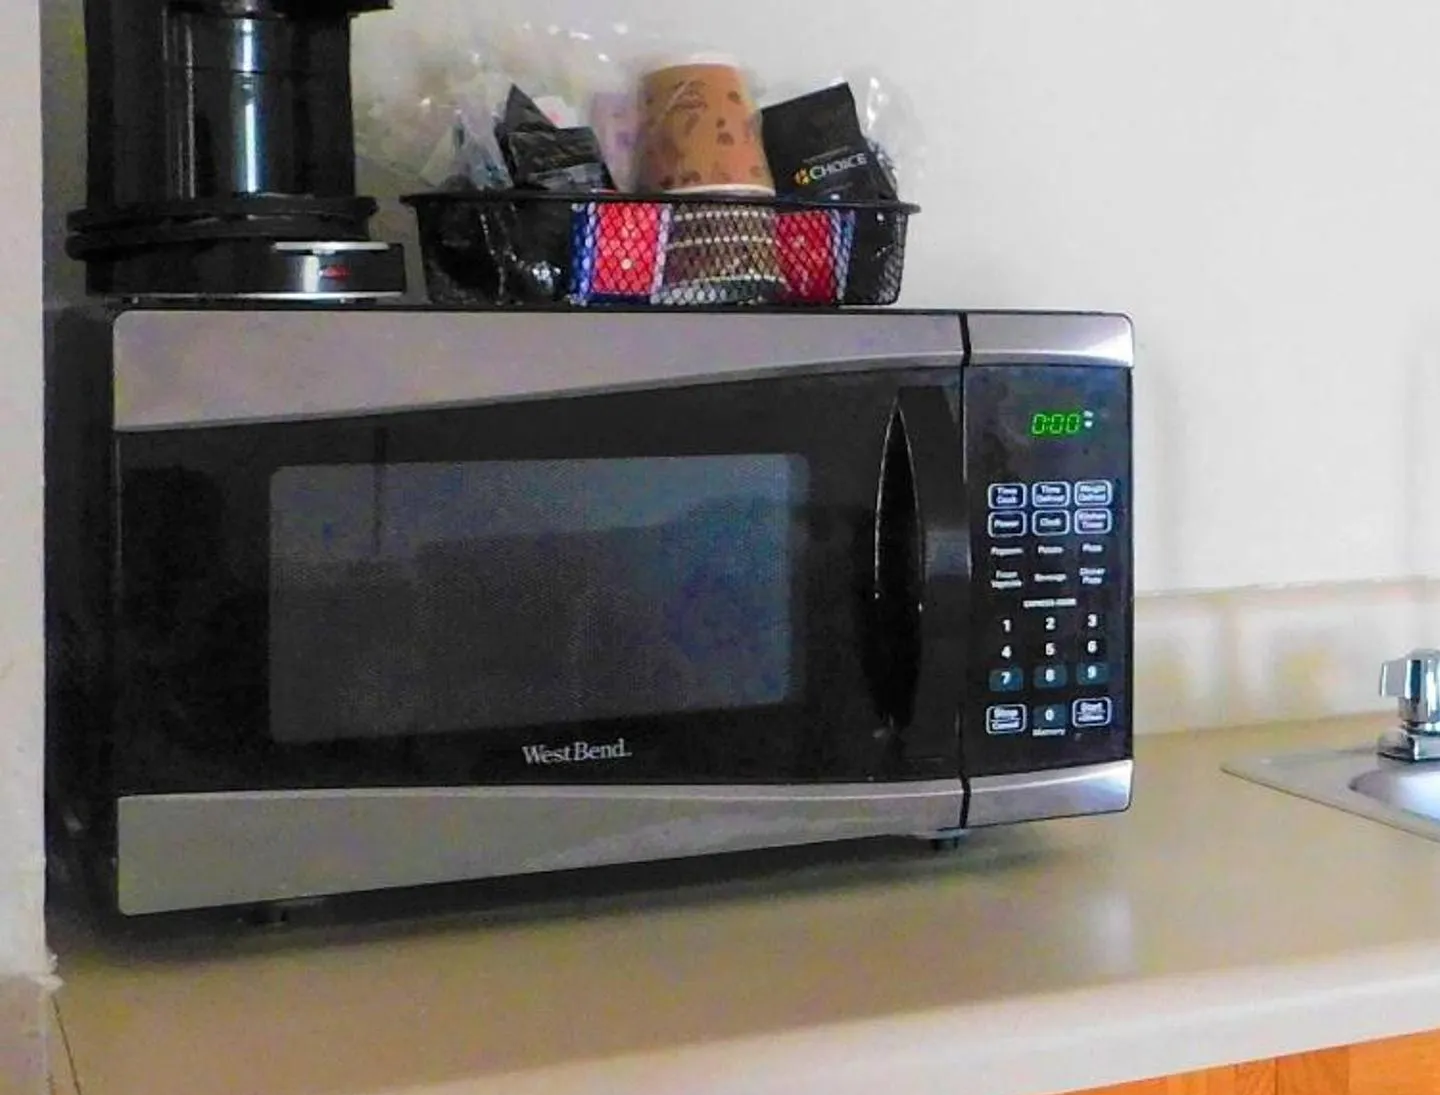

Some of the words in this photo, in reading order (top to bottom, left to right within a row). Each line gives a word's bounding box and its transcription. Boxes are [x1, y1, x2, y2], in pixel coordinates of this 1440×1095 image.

[1031, 413, 1080, 435] 0:00
[1003, 619, 1011, 632] 1
[1045, 617, 1056, 630] 2
[1088, 614, 1097, 627] 3
[1001, 645, 1012, 659] 4
[1045, 642, 1055, 656] 5
[1088, 640, 1097, 653] 6
[1001, 671, 1012, 685] 7
[1045, 668, 1055, 682] 8
[1087, 665, 1097, 679] 9
[1045, 709, 1055, 721] 0
